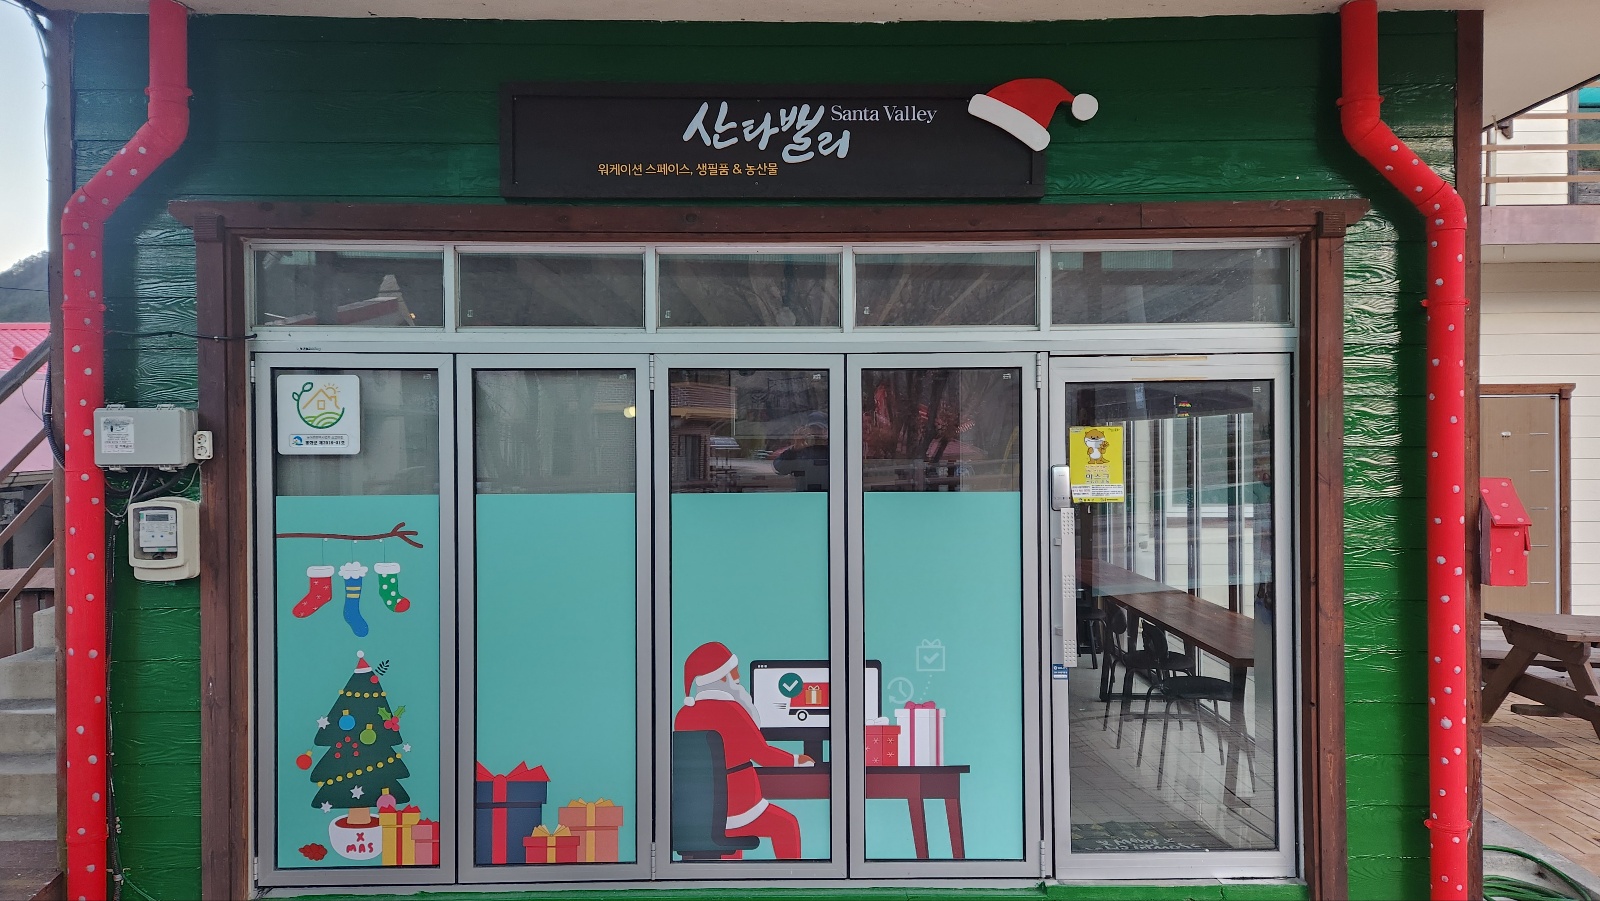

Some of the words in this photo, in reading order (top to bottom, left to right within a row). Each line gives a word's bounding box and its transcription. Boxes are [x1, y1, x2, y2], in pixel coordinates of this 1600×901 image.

[830, 105, 880, 122] Santa
[883, 104, 938, 124] Valley
[682, 101, 851, 163] 산타밸리
[597, 163, 643, 177] 워케이션
[645, 163, 693, 177] 스페이스,
[695, 162, 730, 177] 생필품
[732, 164, 743, 176] &
[744, 162, 779, 177] 농산물
[356, 832, 365, 842] X
[346, 842, 374, 853] MAS
